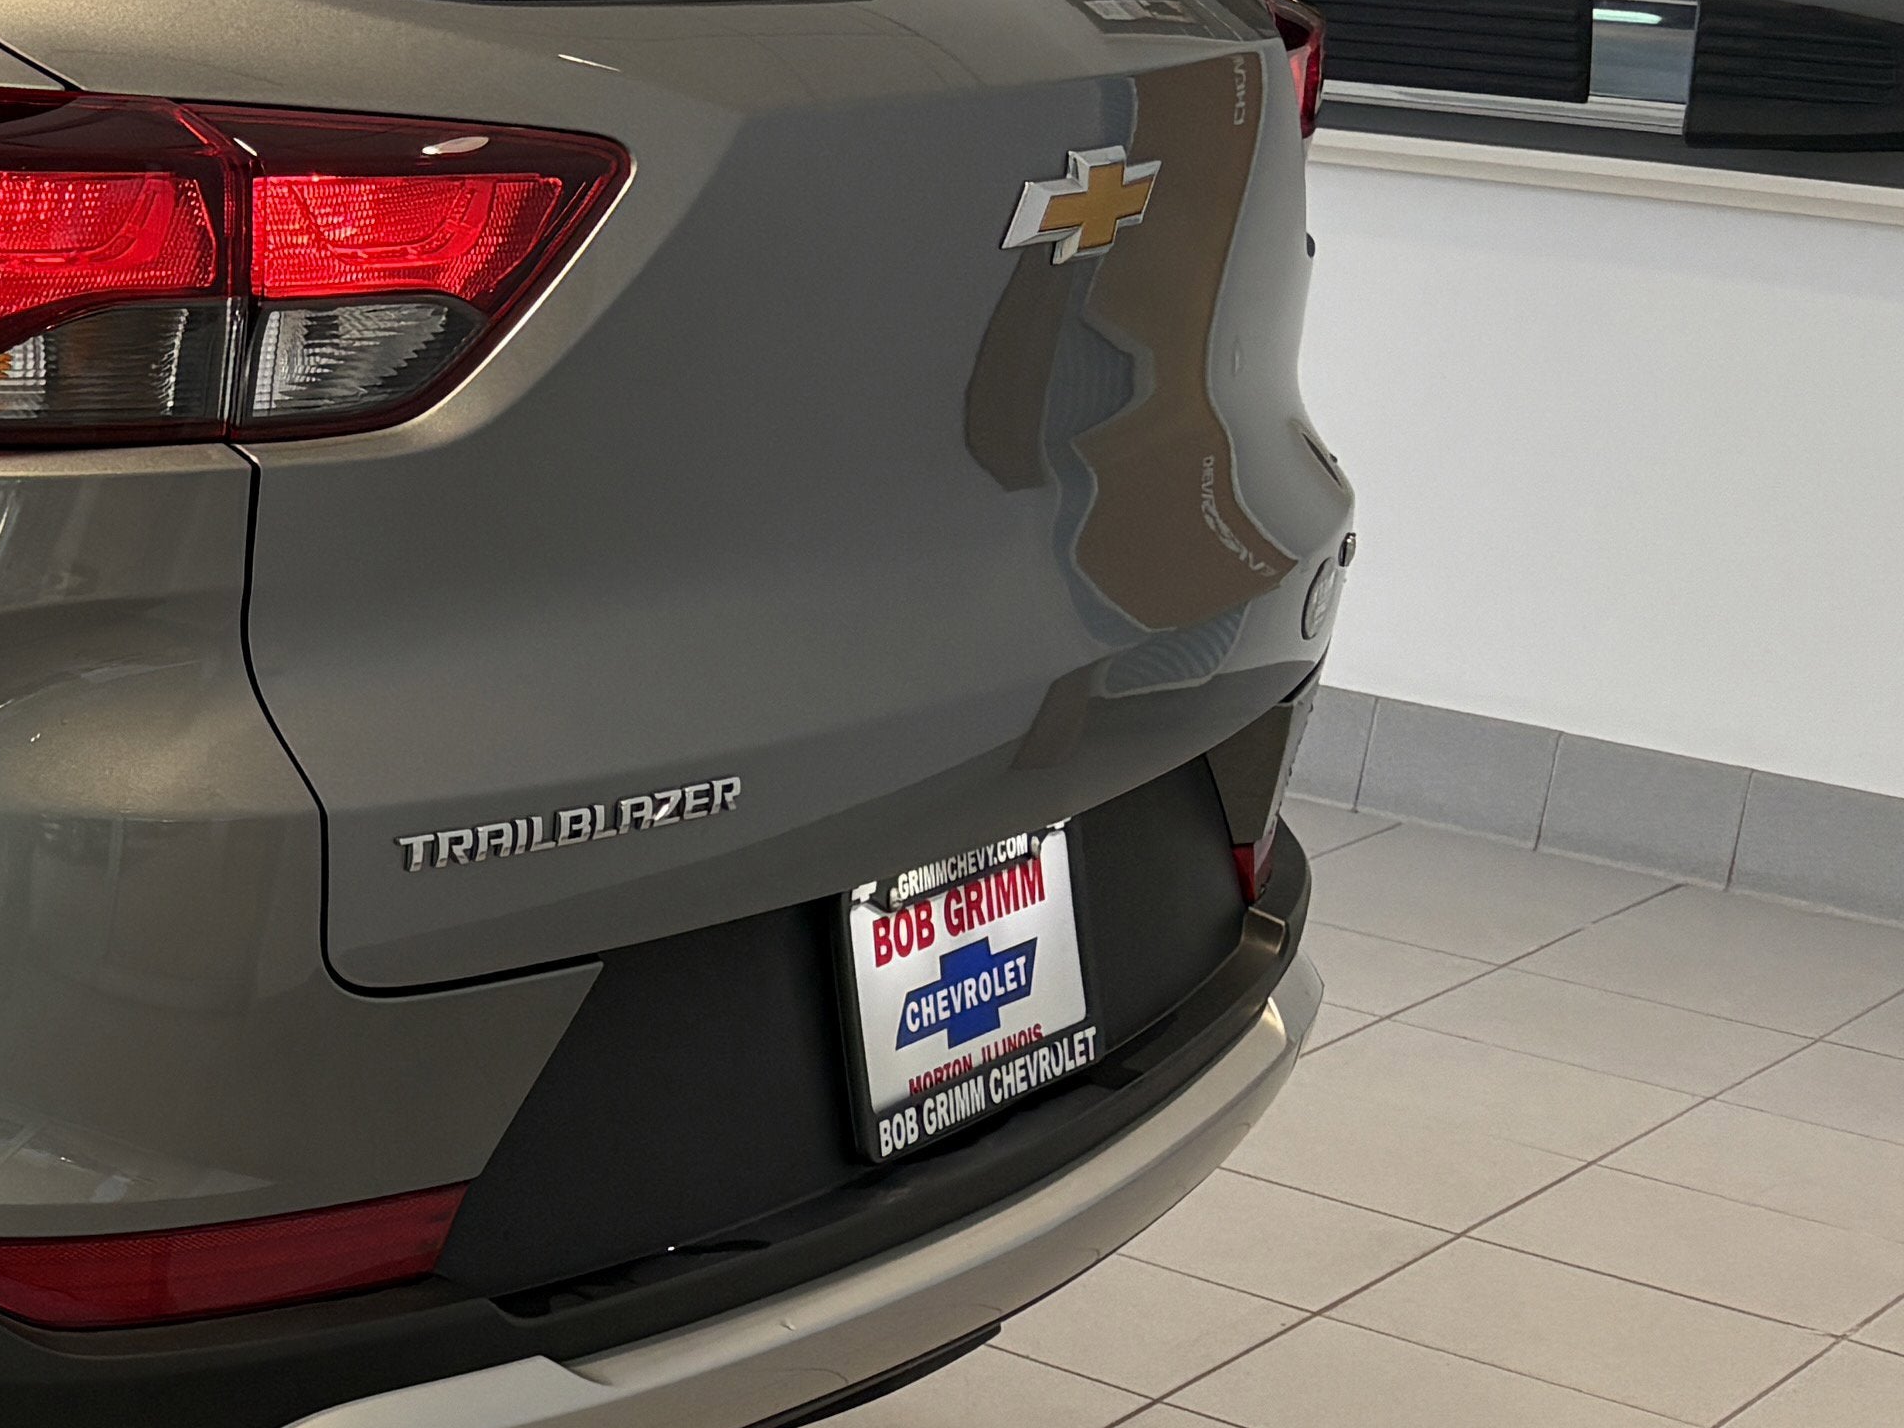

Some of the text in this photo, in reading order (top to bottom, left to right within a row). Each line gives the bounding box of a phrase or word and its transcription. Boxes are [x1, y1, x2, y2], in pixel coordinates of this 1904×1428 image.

[397, 776, 741, 872] TRAILBLAZER
[898, 832, 1028, 899] GRIMMCHEVY.COM
[873, 855, 1045, 968] BOB GRIMM
[905, 956, 1026, 1032] CHEVROLET
[879, 1027, 1096, 1157] BOB GRIMM CHEVROLET
